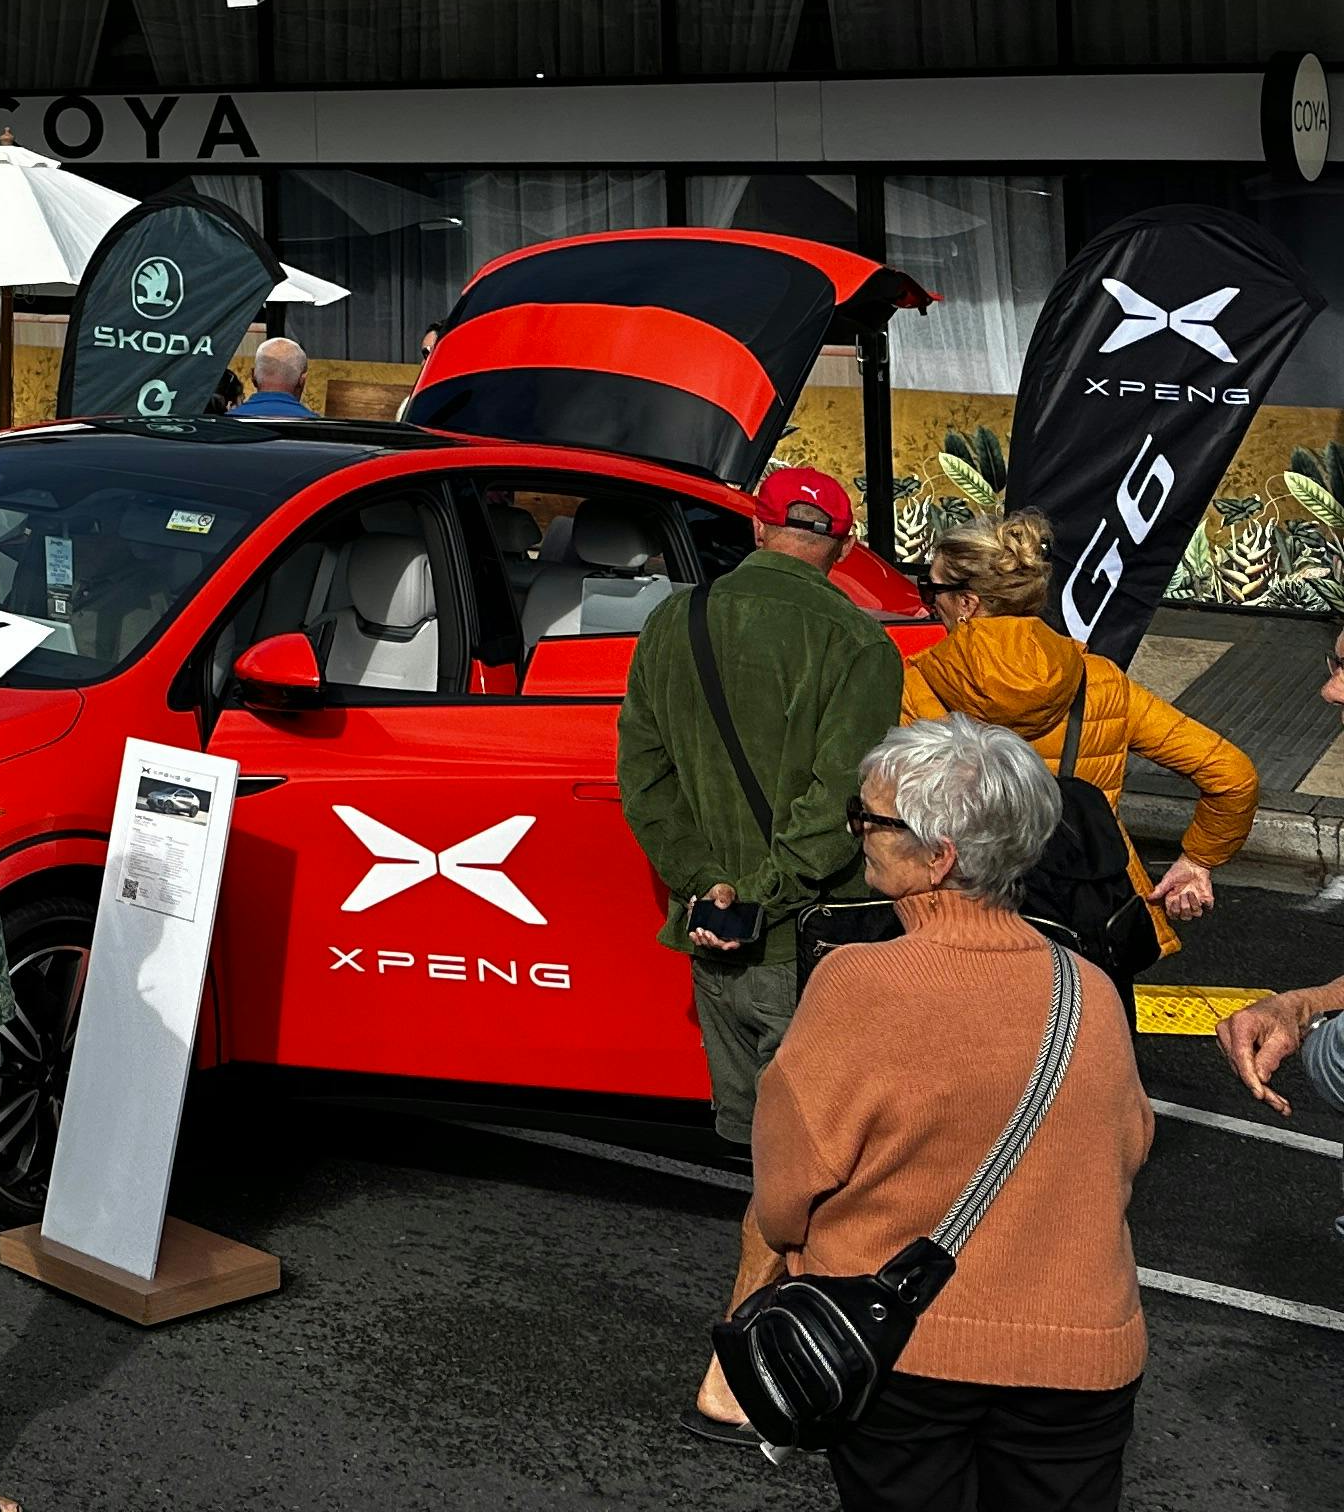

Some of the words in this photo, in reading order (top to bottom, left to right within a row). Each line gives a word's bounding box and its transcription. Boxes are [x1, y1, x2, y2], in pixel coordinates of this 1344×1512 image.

[1294, 100, 1328, 132] COYA
[93, 325, 214, 356] SKODA
[1083, 377, 1251, 406] XPENG
[1061, 433, 1176, 644] G6
[327, 945, 572, 990] XPENG
